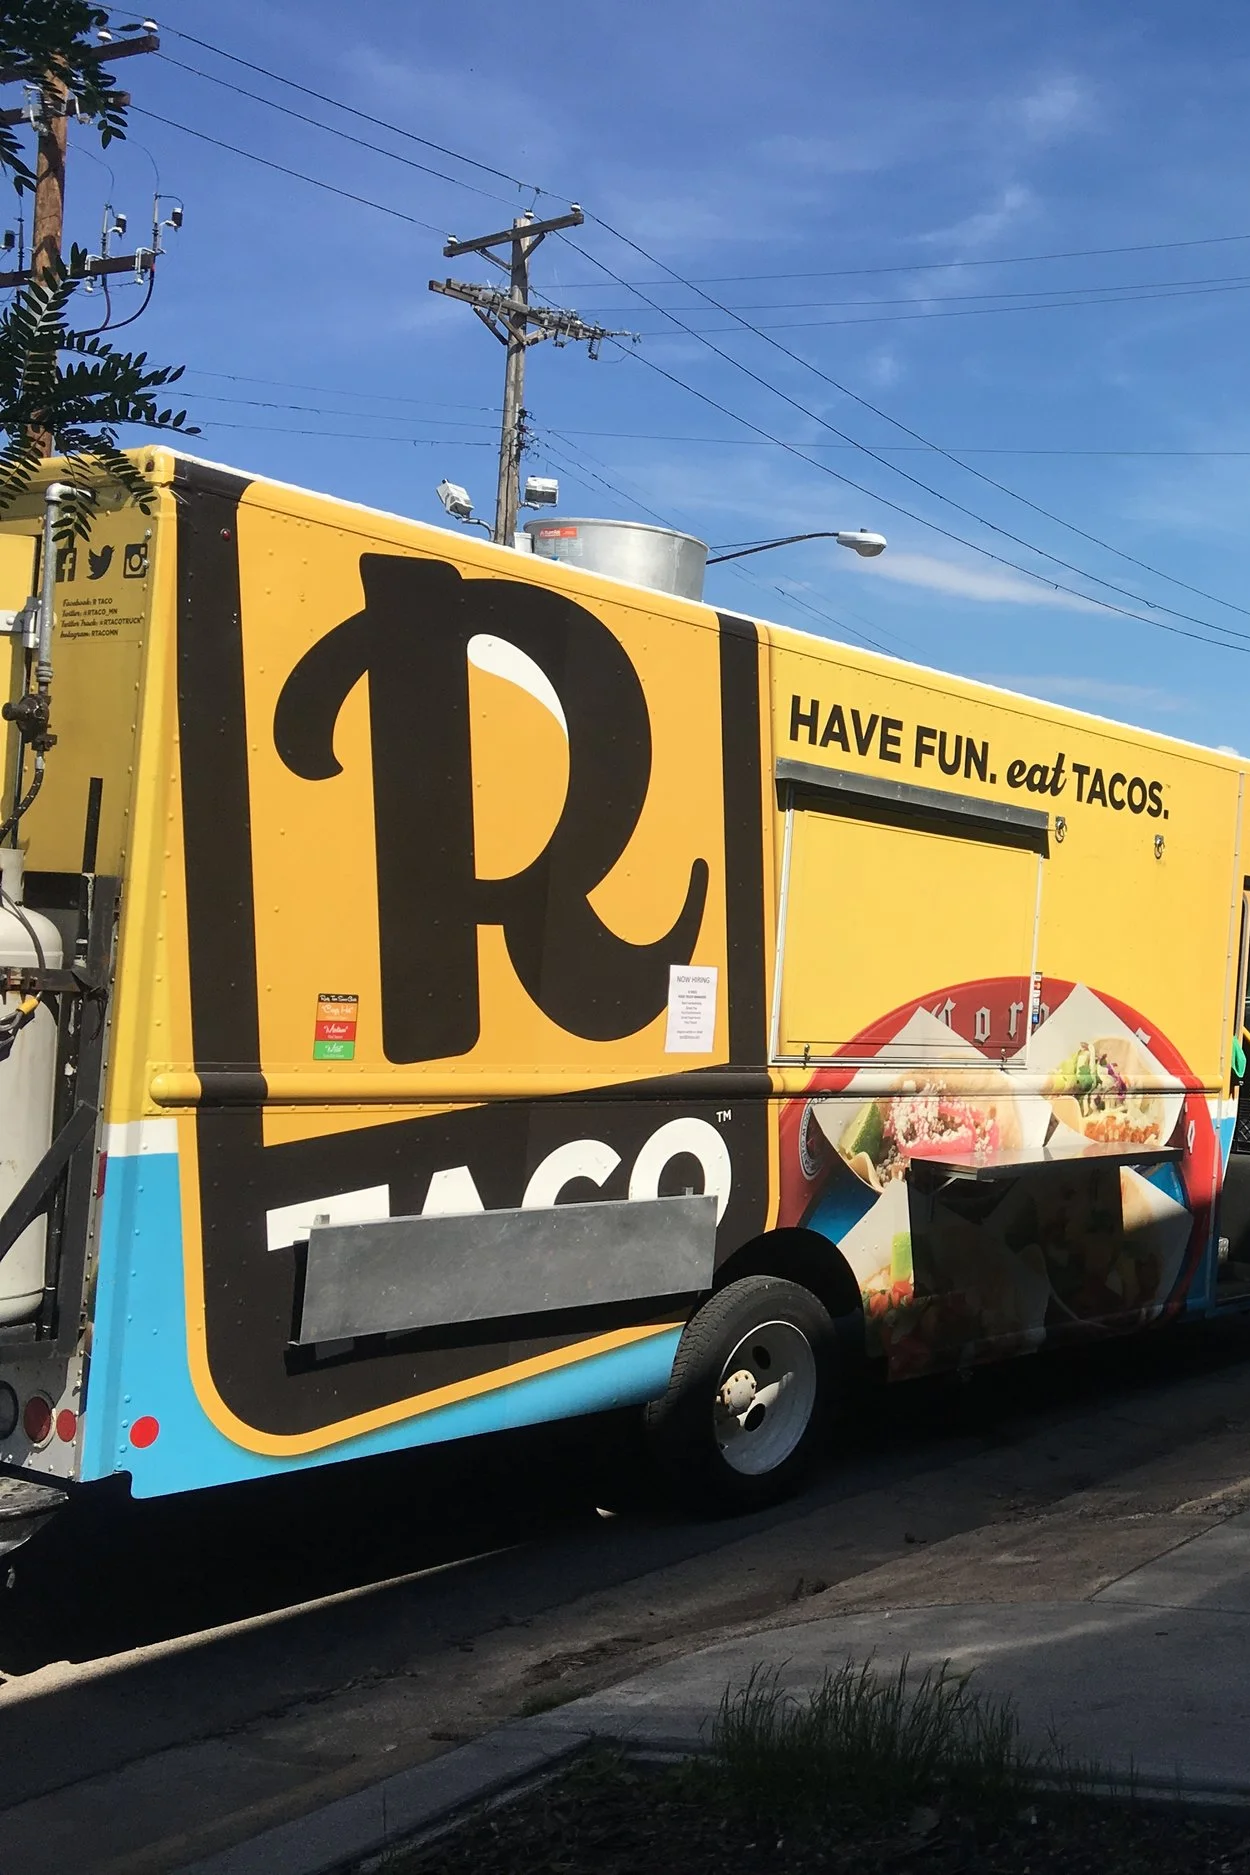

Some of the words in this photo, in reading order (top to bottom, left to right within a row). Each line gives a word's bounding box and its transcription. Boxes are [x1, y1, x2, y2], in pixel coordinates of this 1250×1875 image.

[273, 552, 709, 1065] R
[789, 694, 903, 764] HAVE
[914, 725, 997, 785] FUN.
[1006, 752, 1068, 797] eat
[1072, 762, 1169, 820] TACOS.
[266, 1117, 732, 1251] TCO
